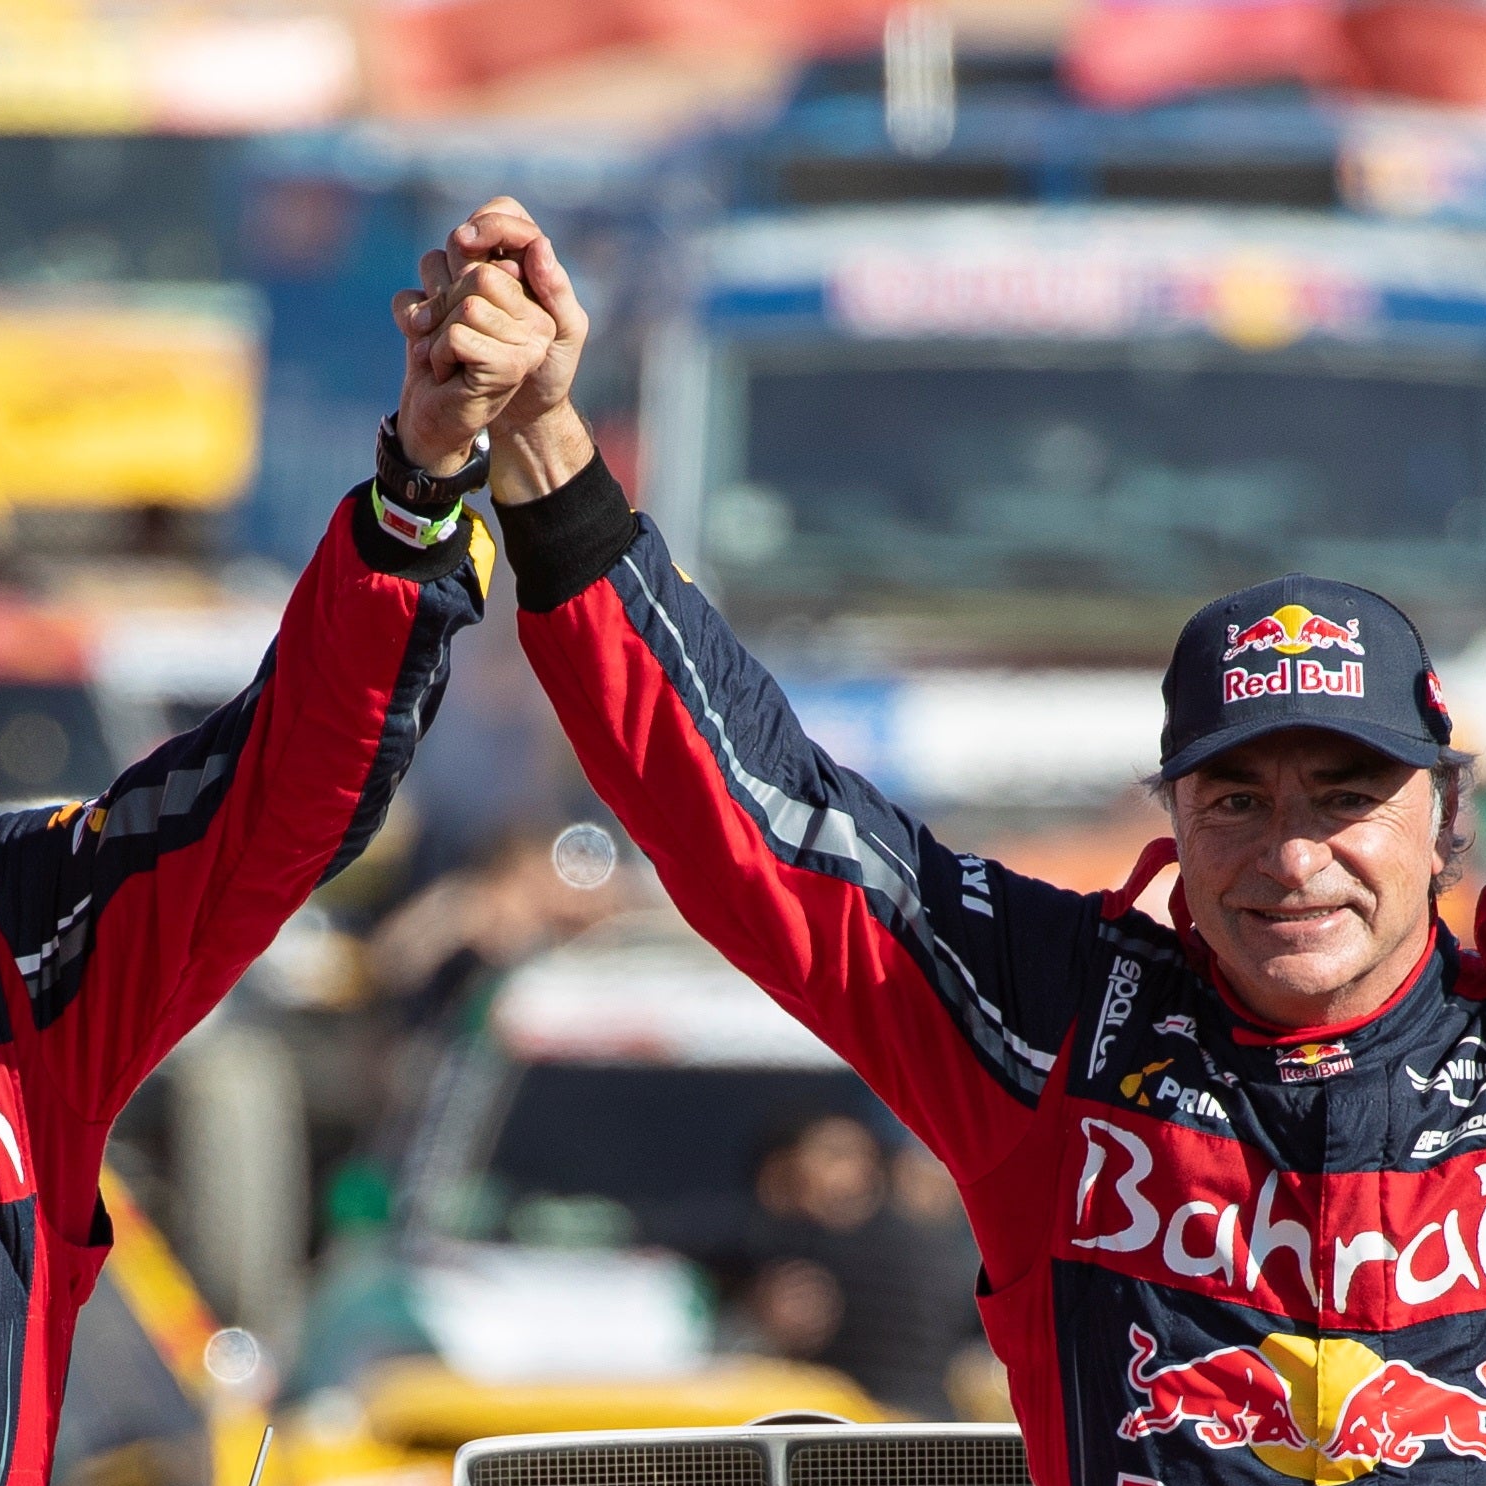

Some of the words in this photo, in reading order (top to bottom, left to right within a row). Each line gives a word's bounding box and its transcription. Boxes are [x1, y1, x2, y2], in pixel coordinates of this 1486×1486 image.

[1223, 657, 1291, 705] Red
[1297, 659, 1365, 698] Bull
[1279, 1061, 1315, 1083] Red
[1317, 1056, 1355, 1080] Bull
